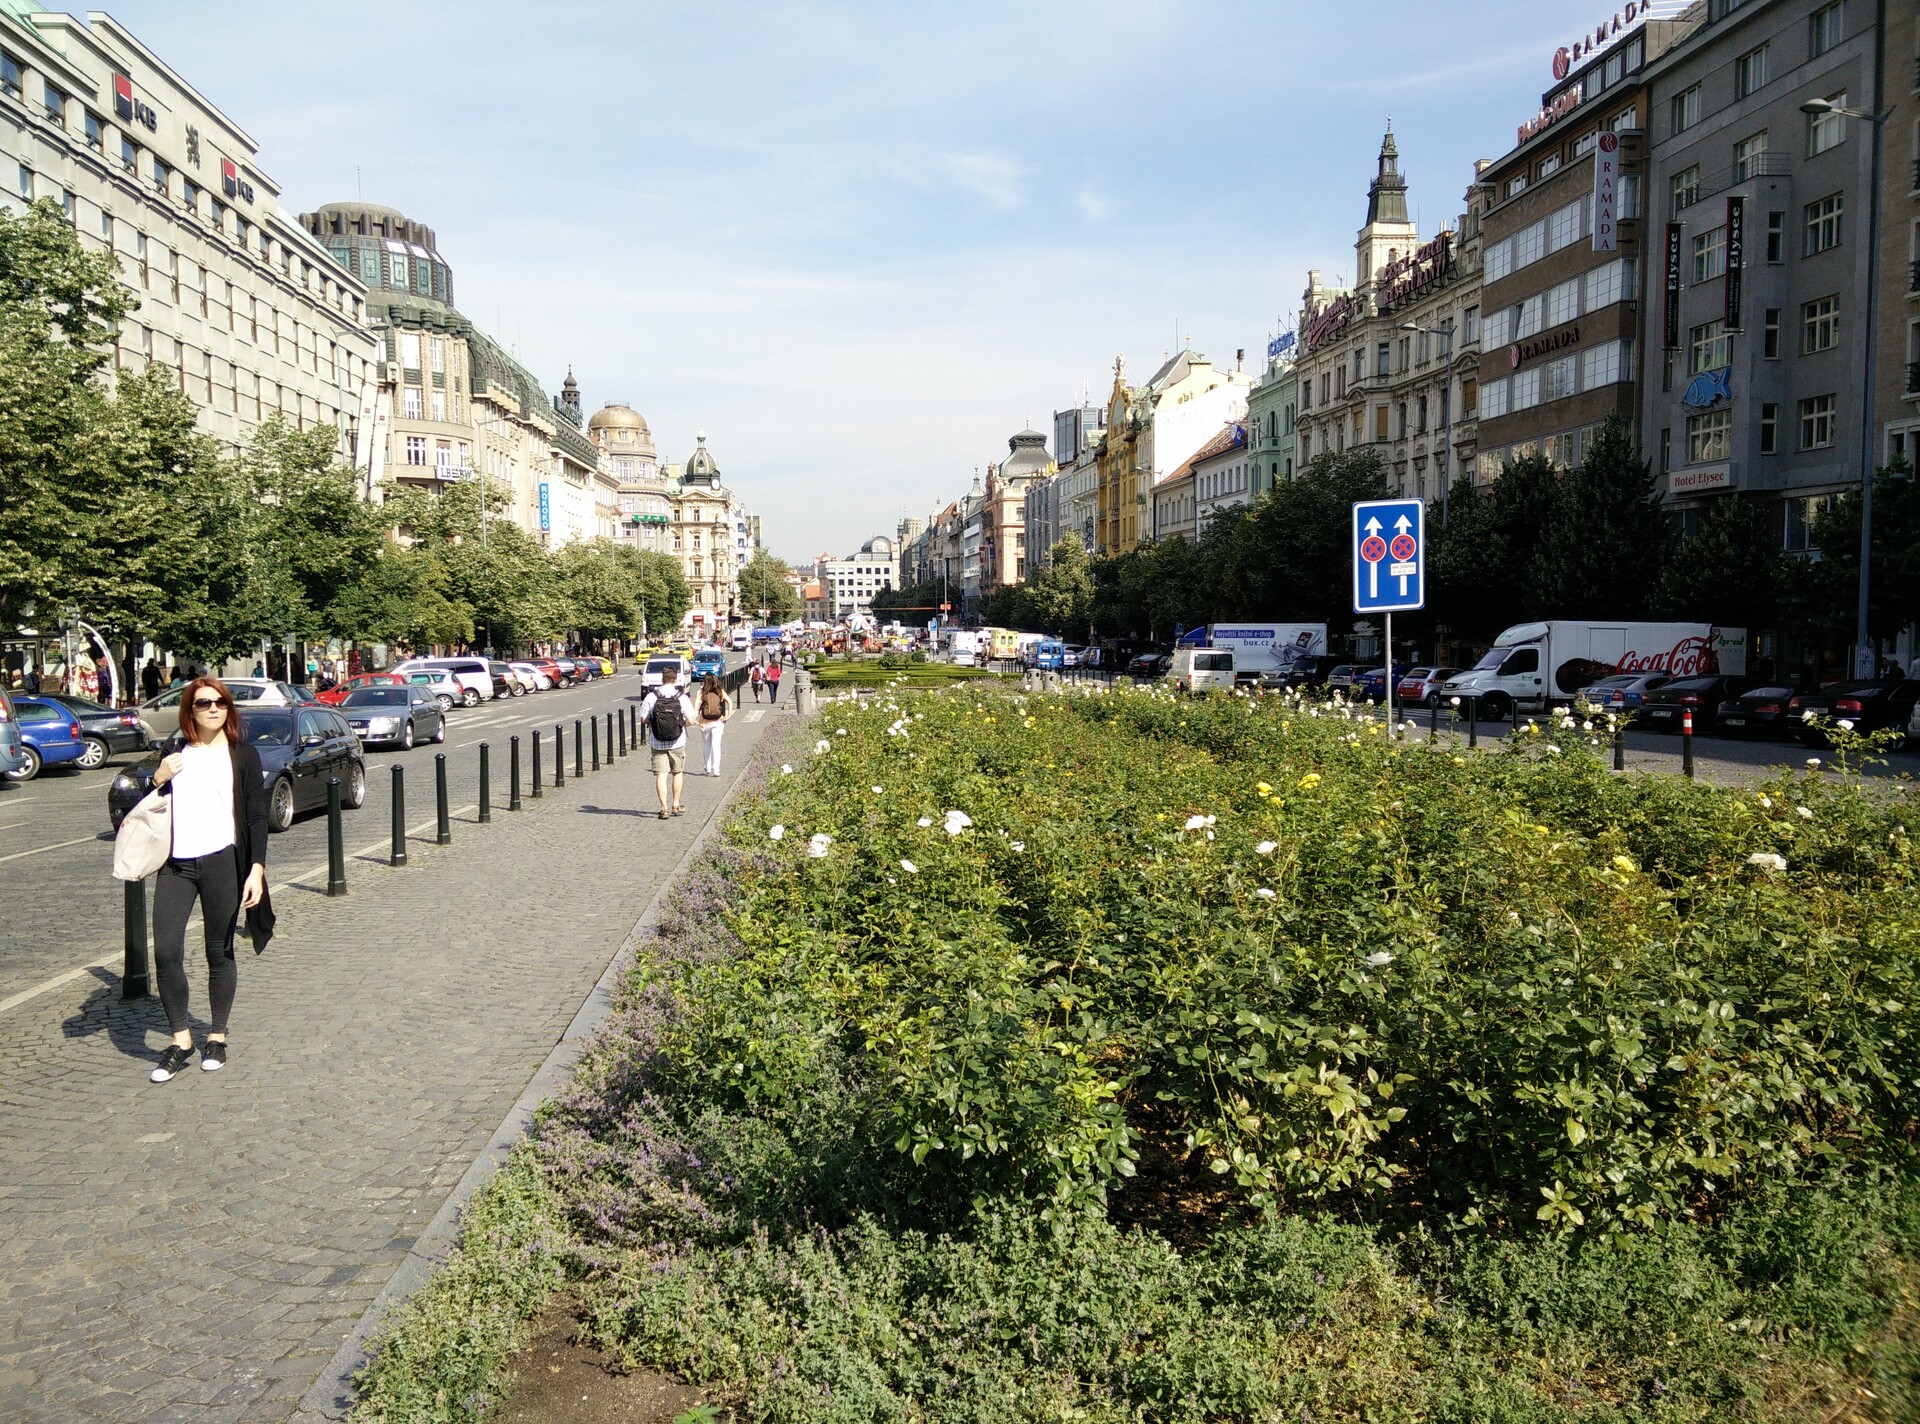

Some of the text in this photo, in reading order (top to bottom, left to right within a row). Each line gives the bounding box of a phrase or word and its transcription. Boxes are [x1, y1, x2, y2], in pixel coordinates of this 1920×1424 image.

[1573, 0, 1651, 61] RAMADA
[133, 97, 157, 132] KB
[1552, 80, 1582, 124] KNIH
[237, 176, 255, 205] KB
[1600, 161, 1613, 250] RAMADA
[1416, 233, 1444, 263] CZECH
[1730, 206, 1742, 268] Elysee
[1668, 232, 1679, 290] Elysee
[1521, 327, 1580, 360] RAMADA
[1674, 472, 1725, 487] Hotel Elysee
[541, 485, 549, 529] ROKOKO
[1254, 630, 1272, 638] e-shop
[1615, 636, 1713, 677] Coca-Col
